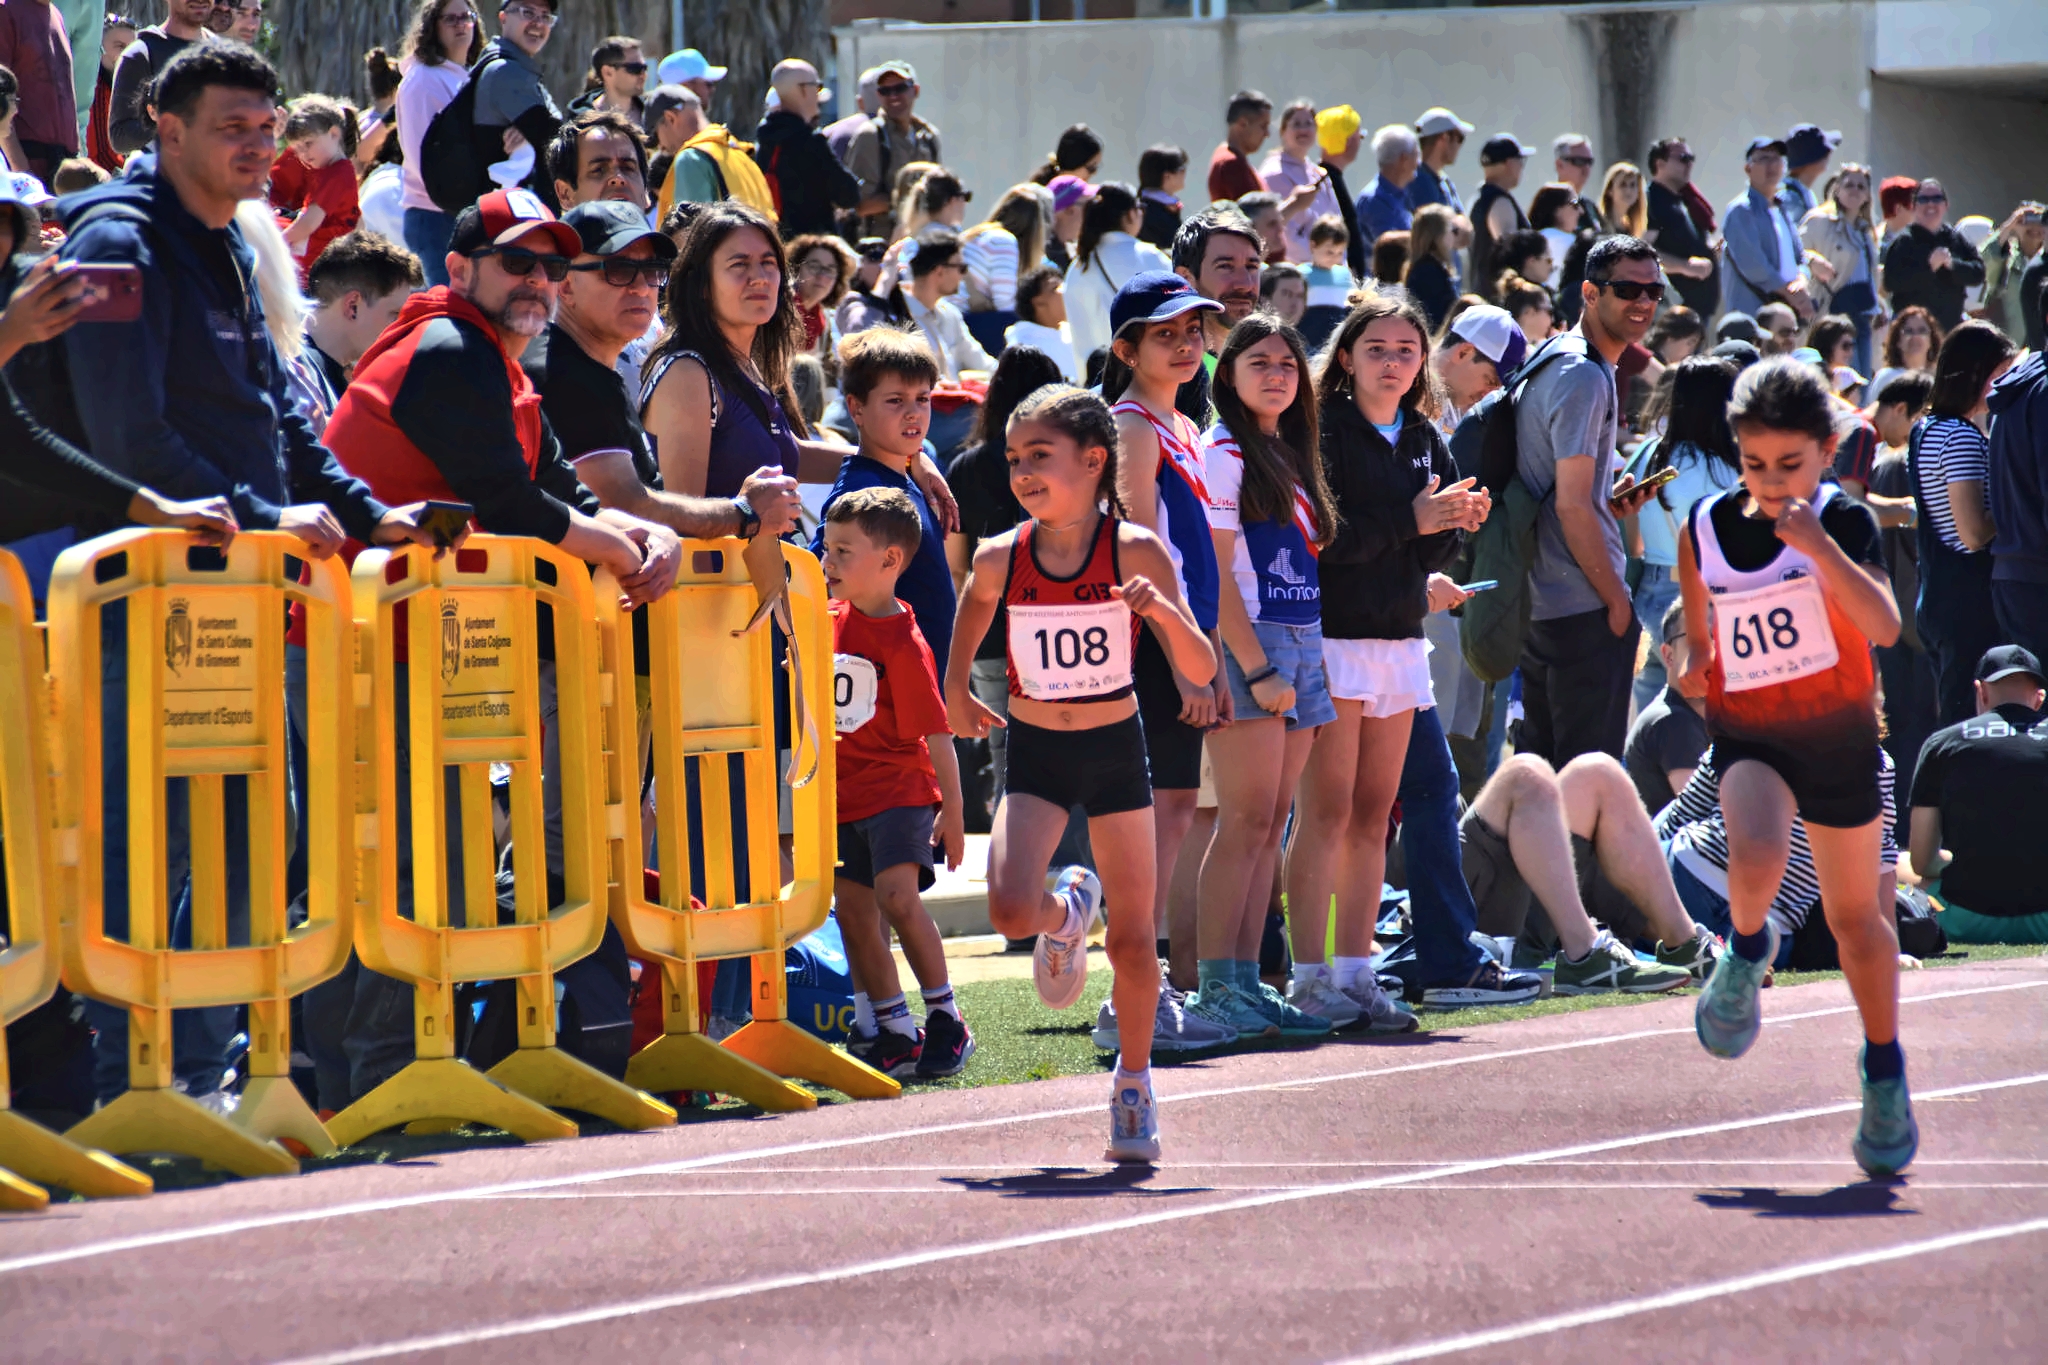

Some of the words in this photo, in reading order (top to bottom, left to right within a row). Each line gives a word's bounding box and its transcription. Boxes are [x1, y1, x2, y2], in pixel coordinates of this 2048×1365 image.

[471, 636, 487, 649] Santa
[1733, 607, 1799, 659] 618
[1034, 626, 1110, 670] 108
[1048, 681, 1070, 691] UCA
